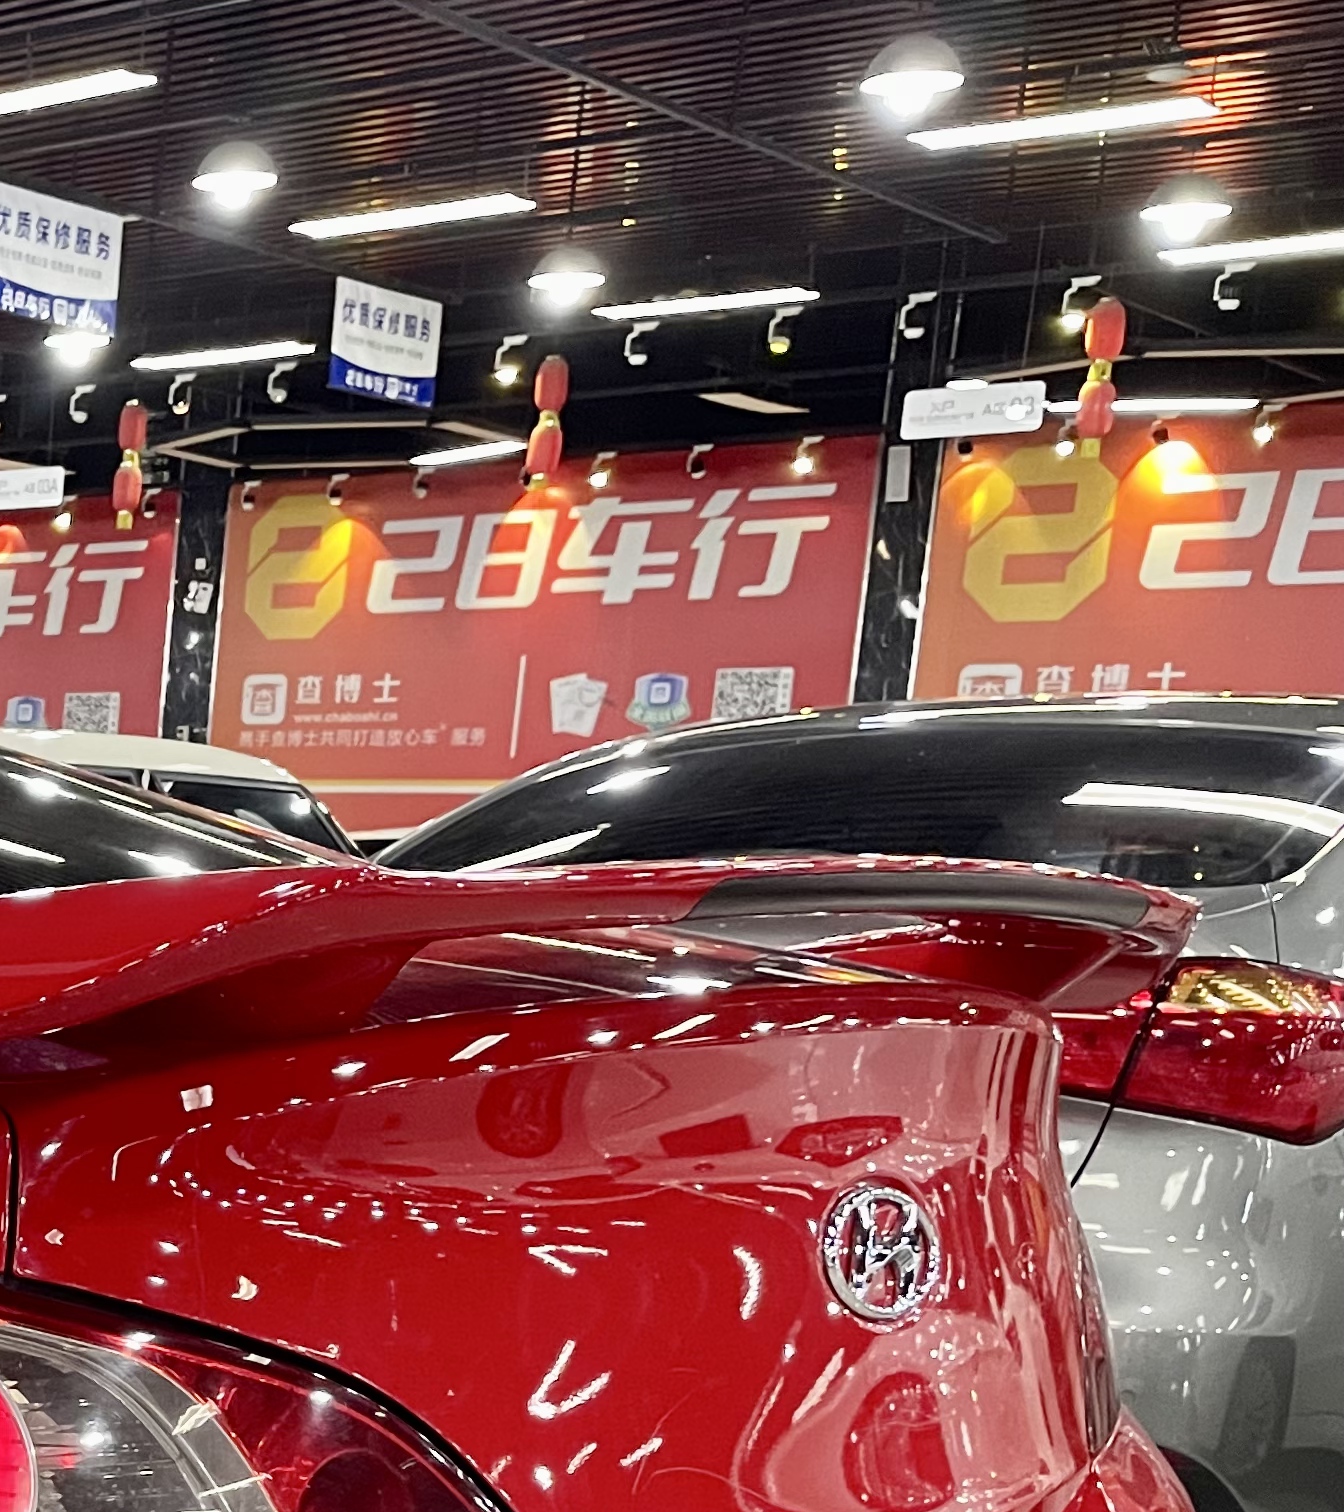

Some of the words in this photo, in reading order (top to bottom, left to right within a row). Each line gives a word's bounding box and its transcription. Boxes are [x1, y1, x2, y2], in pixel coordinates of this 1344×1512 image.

[366, 483, 837, 614] 28车行
[295, 673, 401, 704] 查博士
